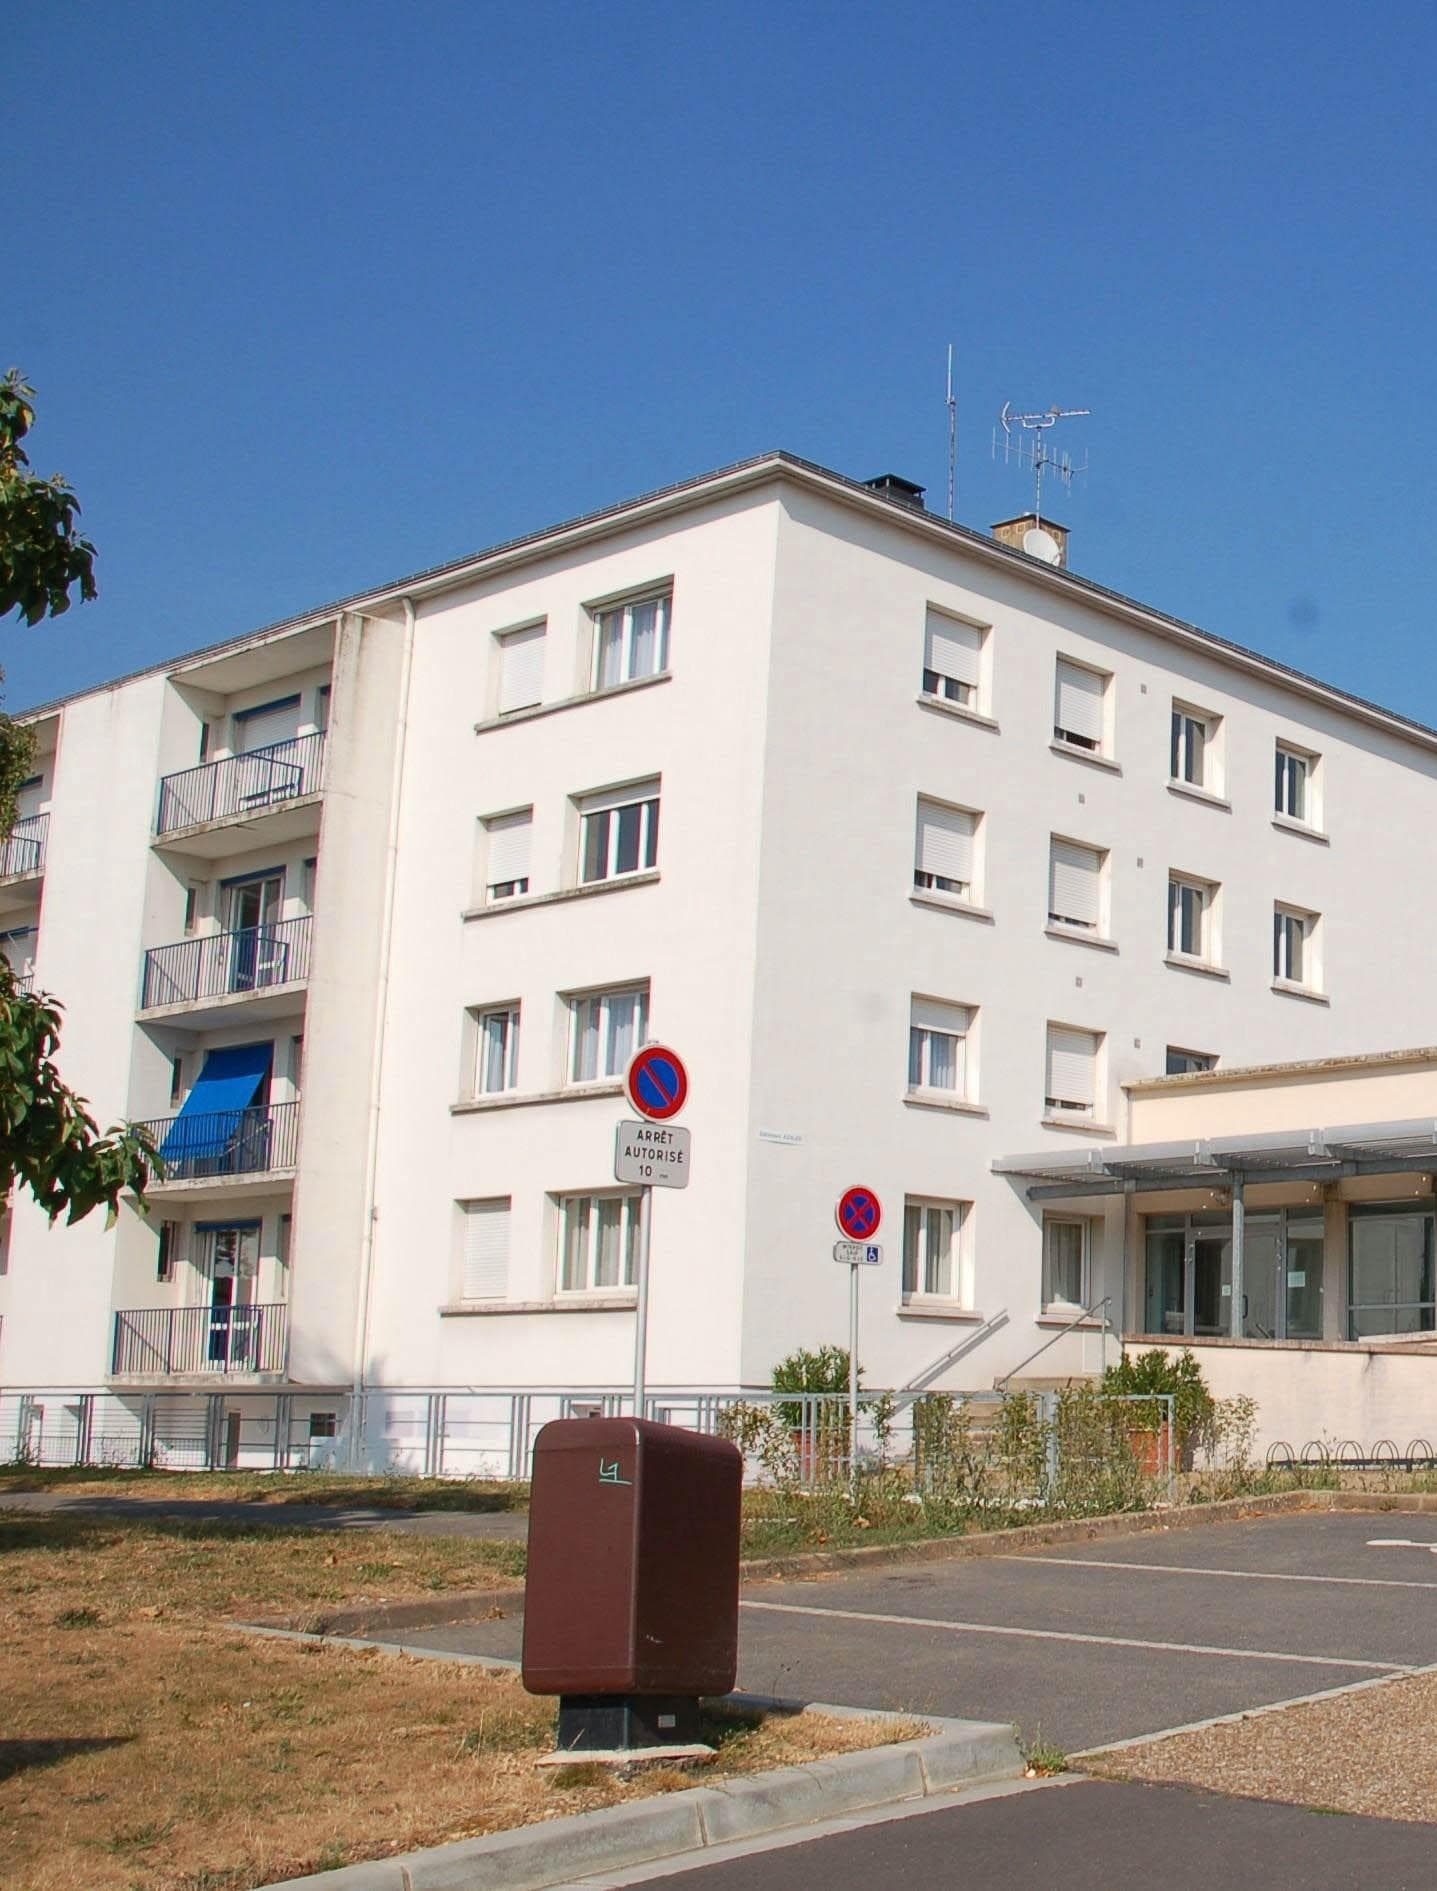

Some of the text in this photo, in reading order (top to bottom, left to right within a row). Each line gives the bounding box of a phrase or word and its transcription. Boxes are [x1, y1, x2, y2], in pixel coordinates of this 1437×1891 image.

[637, 1130, 673, 1144] ARRÊT
[625, 1146, 683, 1163] AUTORISÉ
[639, 1165, 652, 1177] 10
